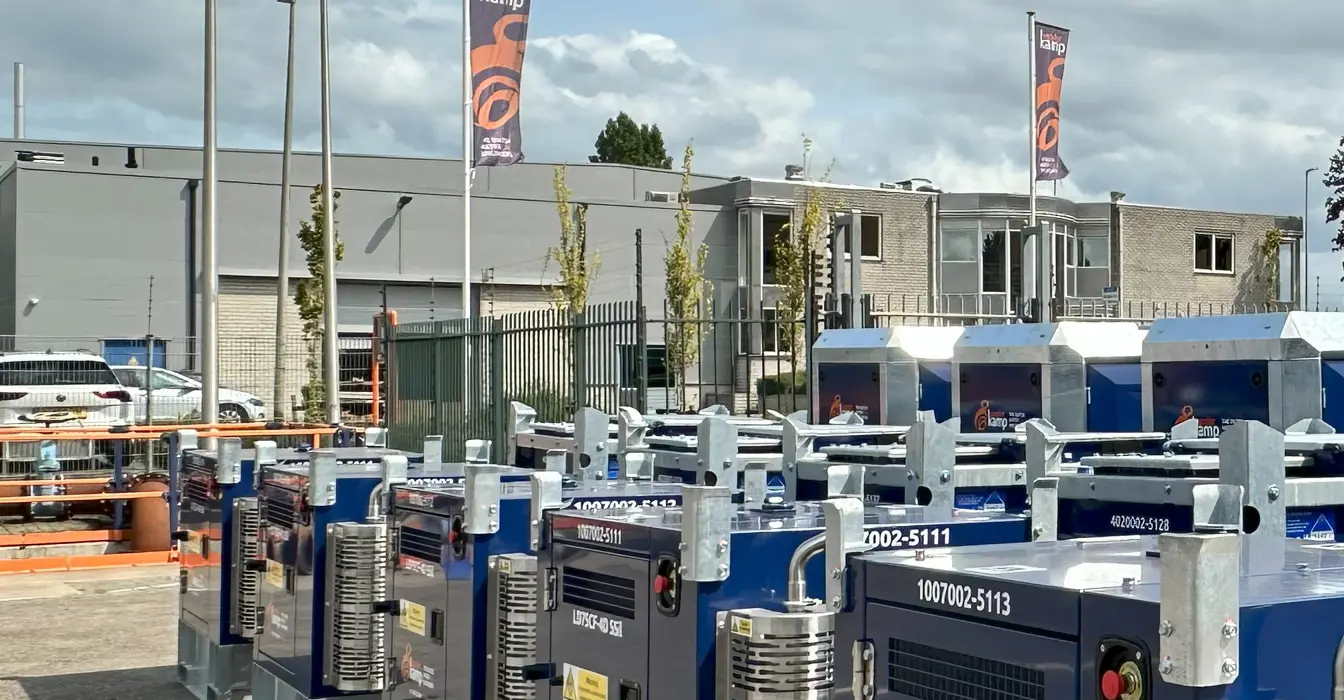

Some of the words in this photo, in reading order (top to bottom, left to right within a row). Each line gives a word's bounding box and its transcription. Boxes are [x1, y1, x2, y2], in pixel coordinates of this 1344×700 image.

[1198, 425, 1220, 439] amp
[1110, 515, 1170, 532] 4020002-5128
[917, 578, 1011, 616] 1007002-5113
